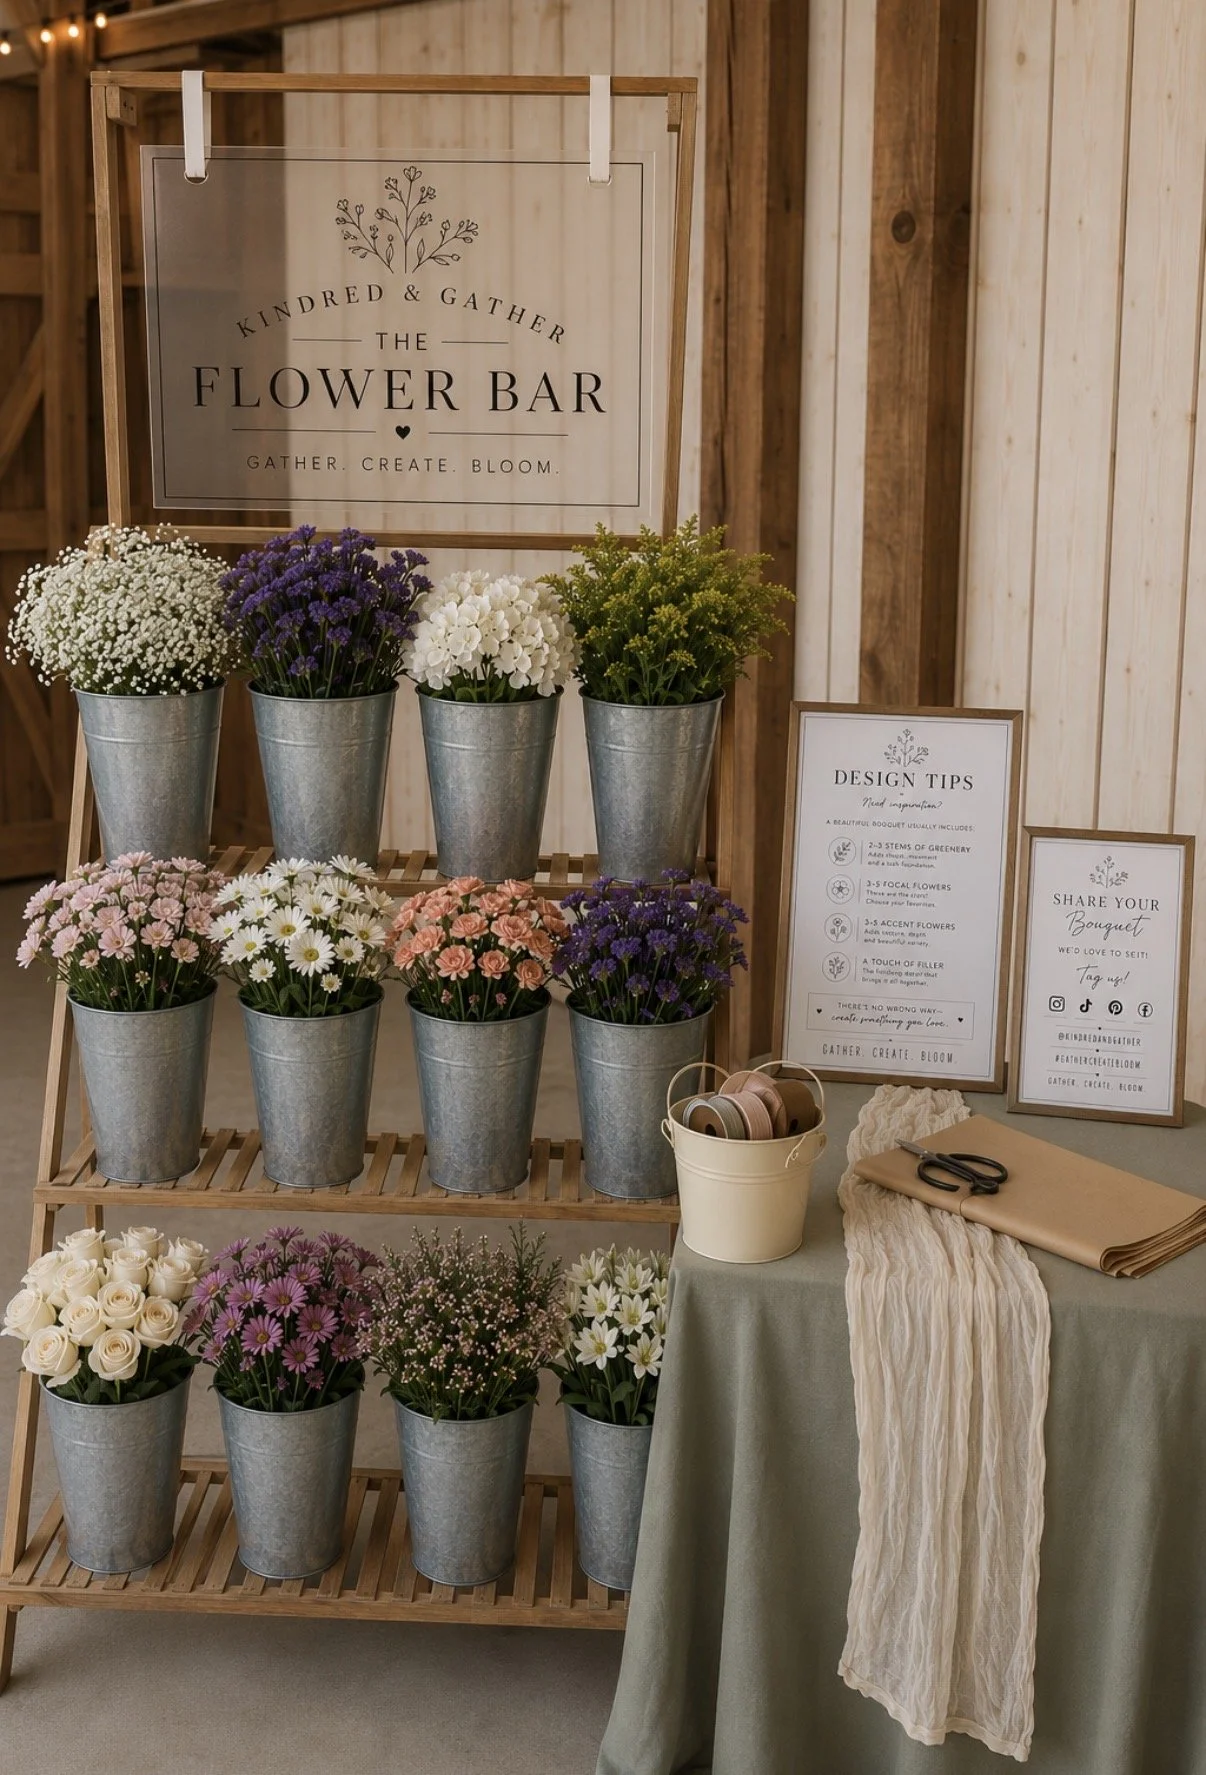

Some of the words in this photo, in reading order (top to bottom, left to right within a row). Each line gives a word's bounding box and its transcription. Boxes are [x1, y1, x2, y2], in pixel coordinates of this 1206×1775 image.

[235, 282, 385, 339] KINDRED
[402, 283, 421, 302] &
[440, 287, 566, 344] GATHER
[375, 332, 429, 351] THE
[191, 365, 461, 412] FLOWER
[488, 370, 608, 413] BAR
[246, 455, 347, 472] GATHER.
[361, 456, 456, 473] CREATE.
[471, 458, 560, 475] BLOOM.
[834, 769, 916, 788] DESIGN
[925, 773, 974, 791] TIPS
[862, 796, 887, 809] Need
[833, 819, 870, 828] BEAUTIFUL
[885, 842, 912, 851] STEMS
[914, 843, 926, 852] OF
[928, 844, 972, 854] GREENERY
[882, 880, 910, 889] FOCAL
[912, 881, 952, 891] FLOWERS
[1052, 893, 1108, 908] SHARE
[1114, 895, 1160, 912] YOUR
[880, 919, 915, 928] ACCENT
[916, 921, 956, 931] FLOWERS
[1065, 910, 1151, 941] Bouquet
[1084, 948, 1107, 956] LOVE
[1110, 949, 1122, 957] TO
[871, 958, 901, 967] TOUCH
[903, 960, 915, 968] OF
[917, 961, 945, 969] FILLER
[1076, 964, 1103, 990] Tag
[871, 1004, 884, 1012] NO
[886, 1005, 917, 1013] WRONG
[822, 1043, 865, 1057] GATHER.
[872, 1047, 914, 1061] CREATE.
[920, 1050, 958, 1064] BLOOM.
